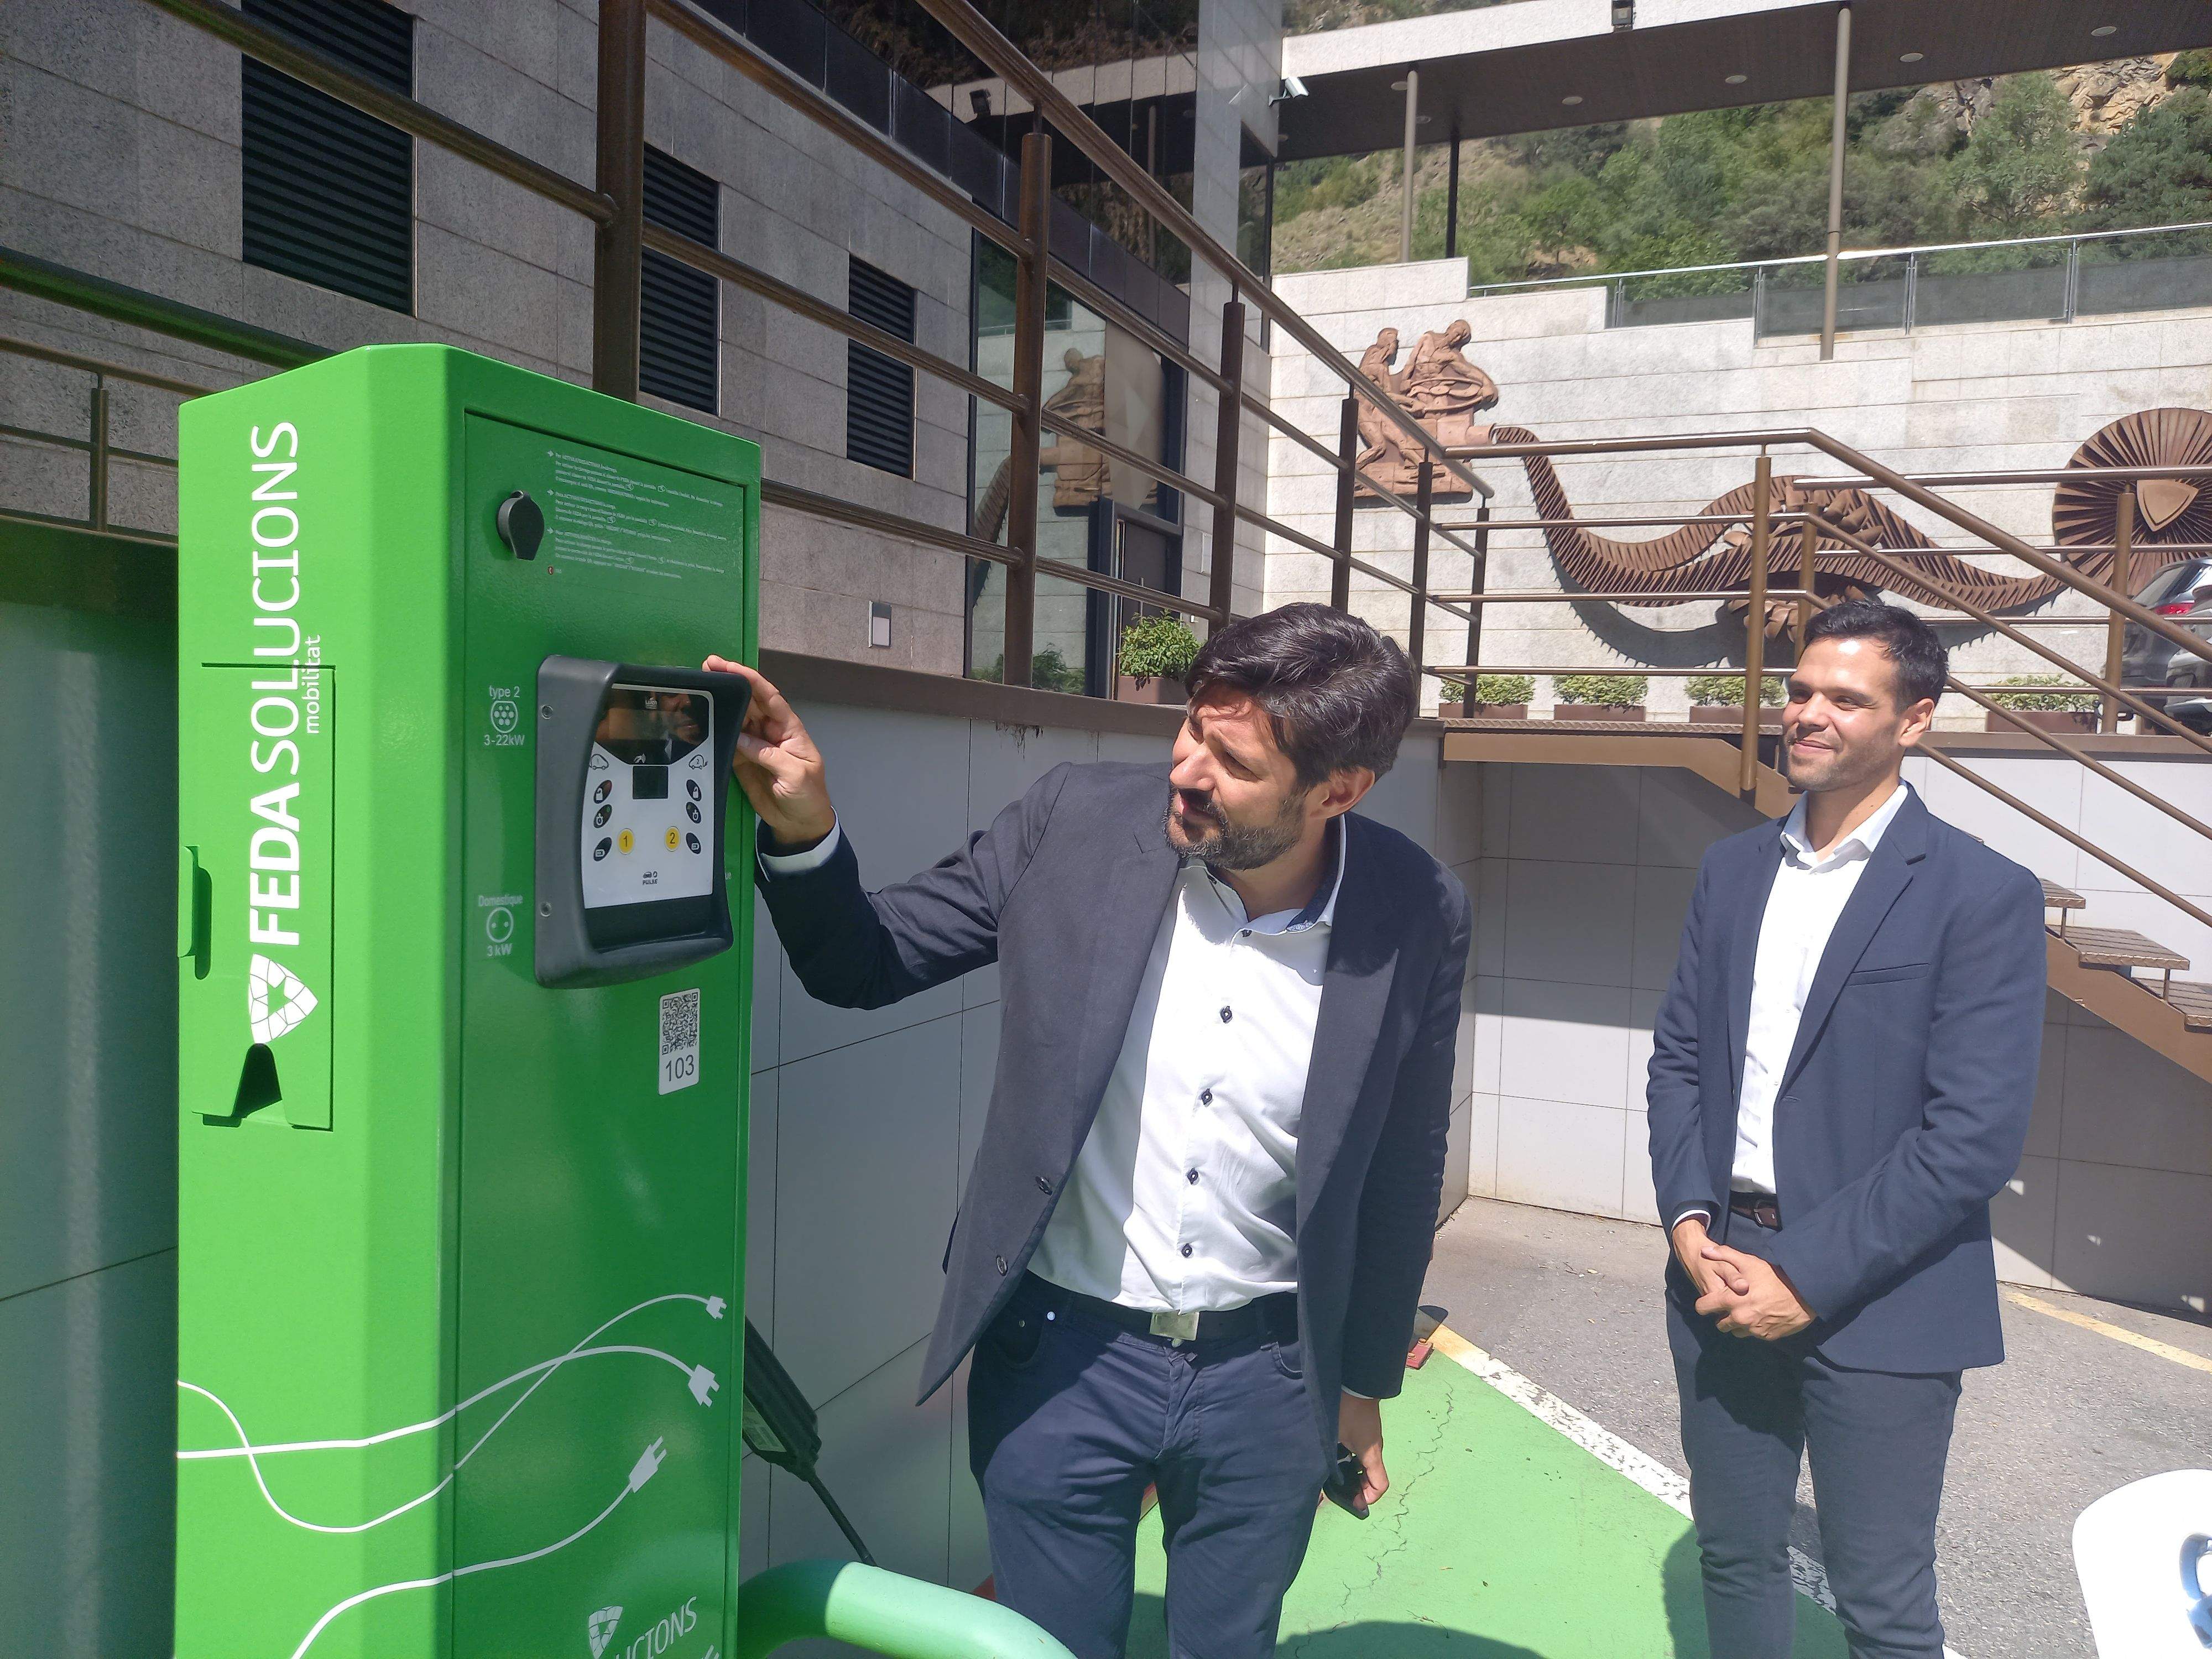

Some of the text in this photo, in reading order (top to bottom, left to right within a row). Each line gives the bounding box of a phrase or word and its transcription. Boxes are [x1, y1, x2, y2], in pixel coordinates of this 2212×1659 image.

[301, 634, 321, 734] mobilitat
[489, 685, 520, 700] type 2
[484, 734, 525, 746] 3-22kW
[623, 836, 628, 847] 1
[670, 832, 675, 844] 2
[487, 945, 493, 957] 3
[665, 1054, 695, 1082] 103
